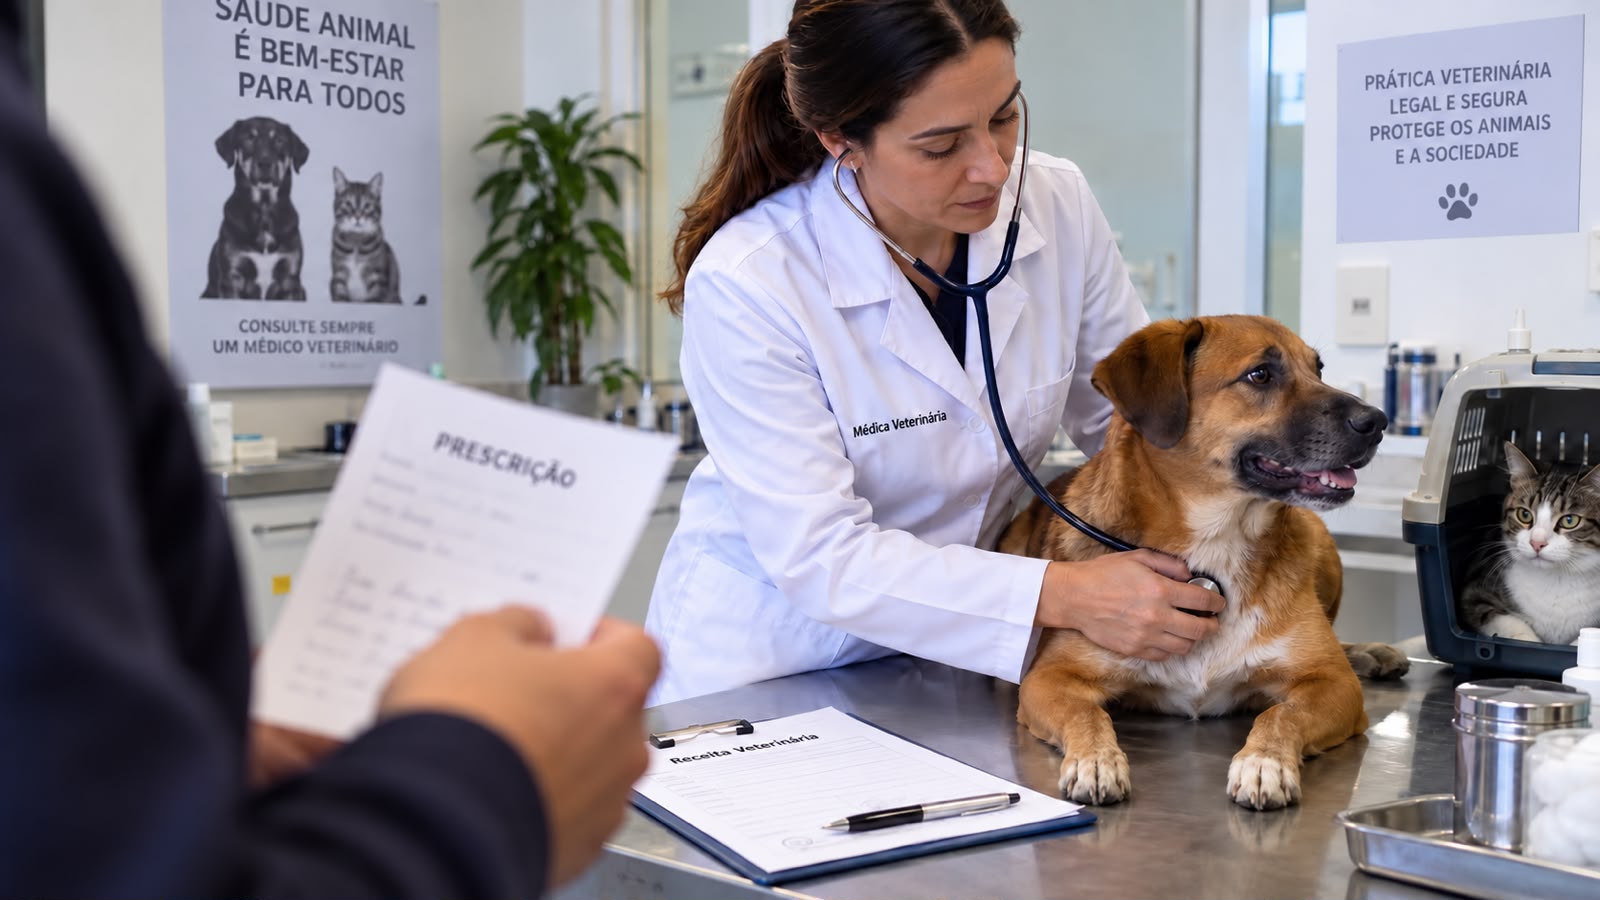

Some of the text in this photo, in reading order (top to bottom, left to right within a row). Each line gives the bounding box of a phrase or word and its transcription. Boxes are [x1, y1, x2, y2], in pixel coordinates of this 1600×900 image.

[318, 11, 415, 50] ANIMAL
[235, 27, 405, 82] É BEM-ESTAR
[1364, 59, 1552, 91] PRÁTICA VETERINÁRIA
[238, 71, 406, 115] PARA TODOS
[1389, 89, 1528, 115] LEGAL E SEGURA
[1369, 113, 1552, 142] PROTEGE OS ANIMAIS
[1395, 141, 1519, 165] E A SOCIEDADE
[238, 318, 376, 336] CONSULTE SEMPRE
[212, 337, 399, 354] UM MÉDICO VETERINÁRIO
[852, 410, 947, 438] Médica Veterinária
[432, 430, 578, 489] PRESCRIÇÃO
[670, 734, 819, 764] Receita Veterinária
